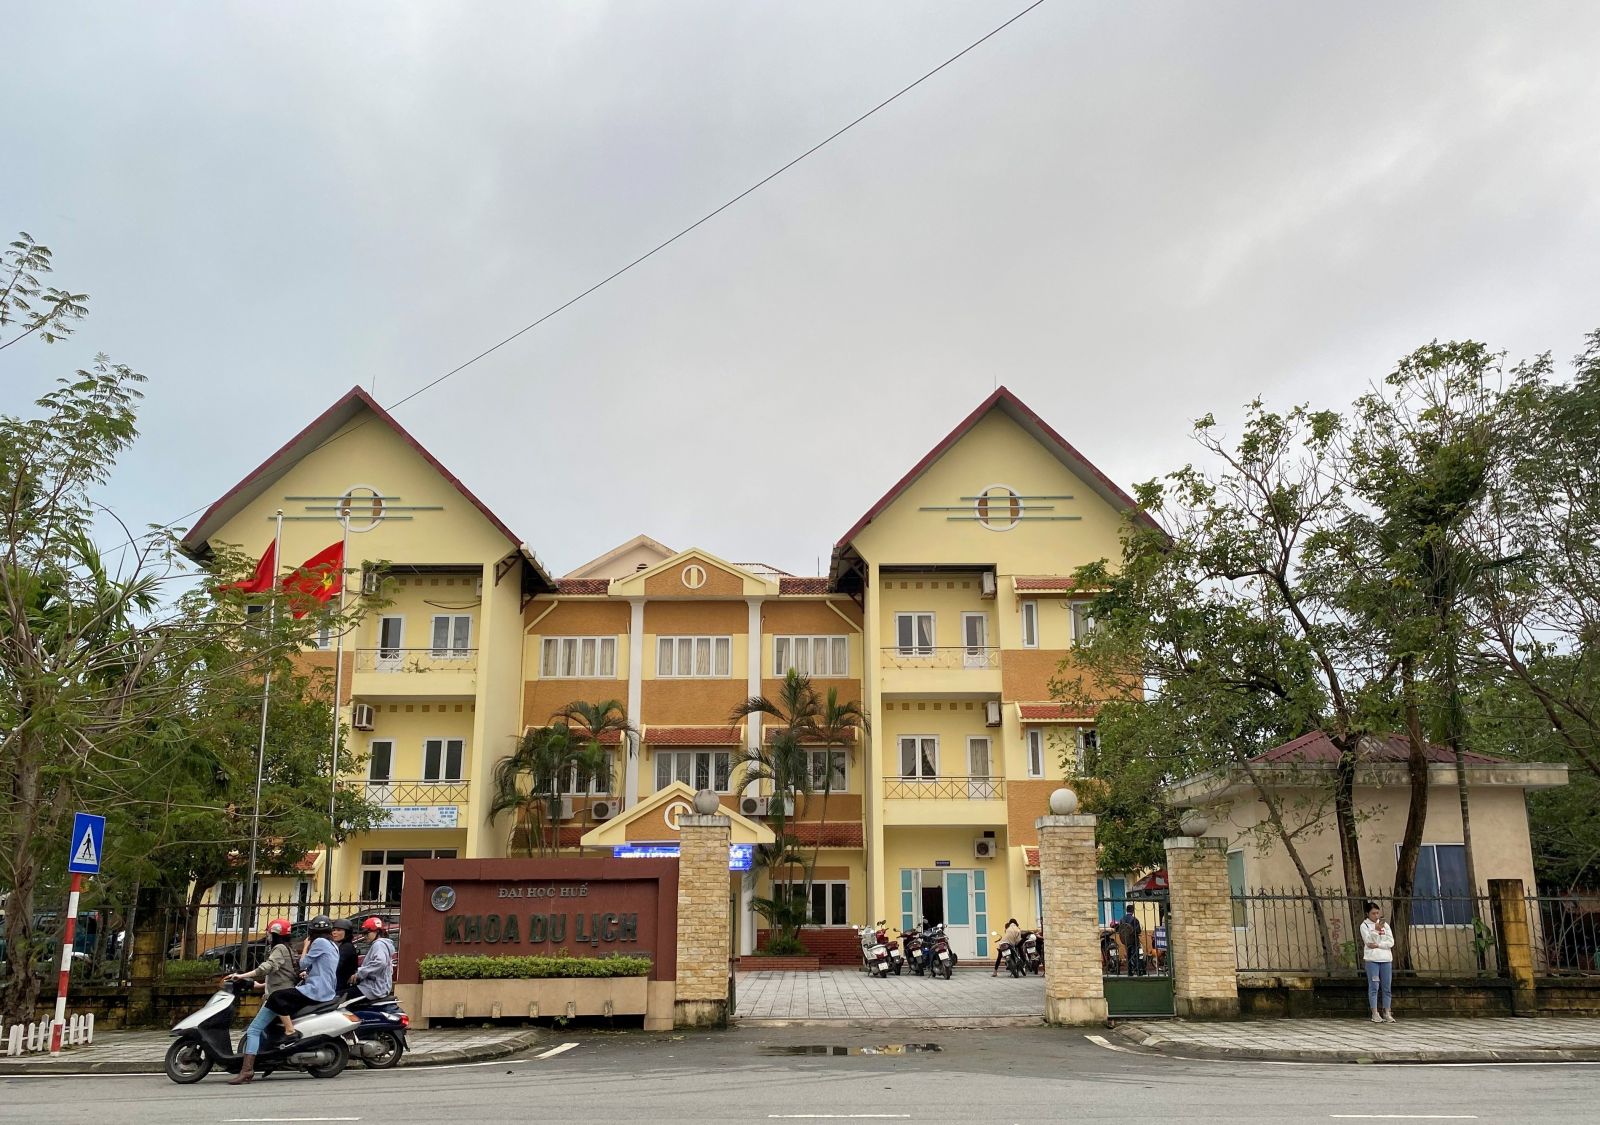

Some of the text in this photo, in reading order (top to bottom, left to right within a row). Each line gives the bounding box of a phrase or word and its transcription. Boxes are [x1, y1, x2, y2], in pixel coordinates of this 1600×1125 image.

[526, 887, 556, 901] HỌC
[560, 882, 588, 897] HUẾ
[444, 912, 638, 947] KHOA DU LỊCH
